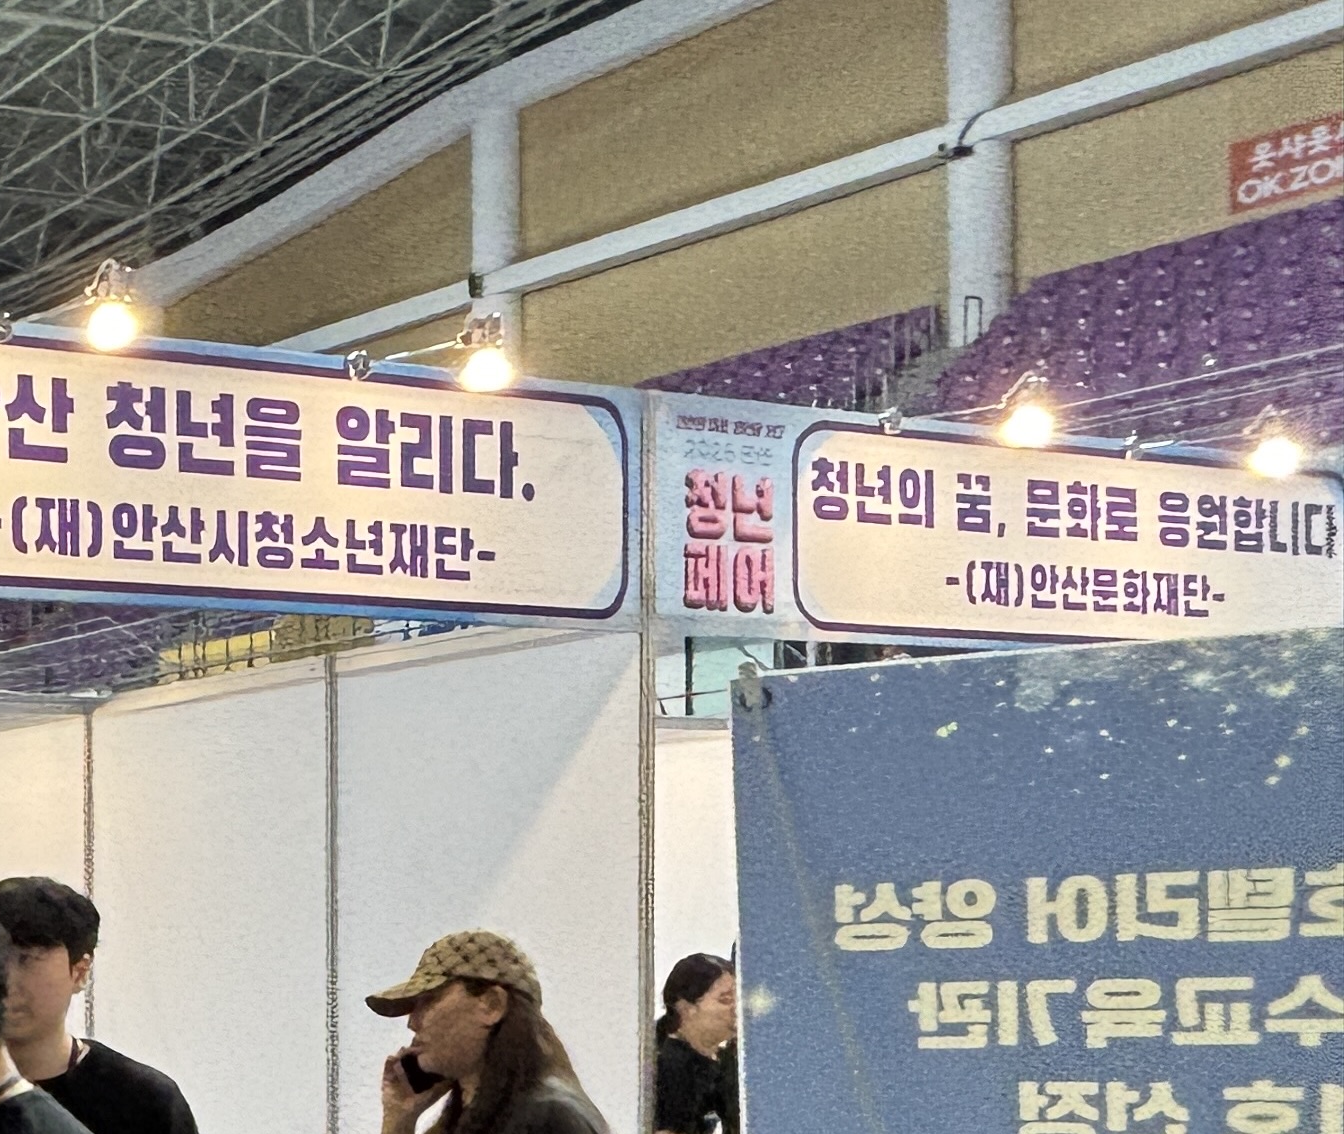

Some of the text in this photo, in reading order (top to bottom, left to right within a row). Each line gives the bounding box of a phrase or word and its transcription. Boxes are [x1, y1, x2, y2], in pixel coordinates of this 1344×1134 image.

[106, 380, 303, 481] 청년을
[335, 405, 537, 500] 알리다.
[684, 468, 774, 543] 청년
[811, 456, 1337, 559] 청년의 꿈, 문화로 응원합니다
[684, 543, 775, 614] 페어
[945, 562, 1225, 618] -(재)안산문화재단-
